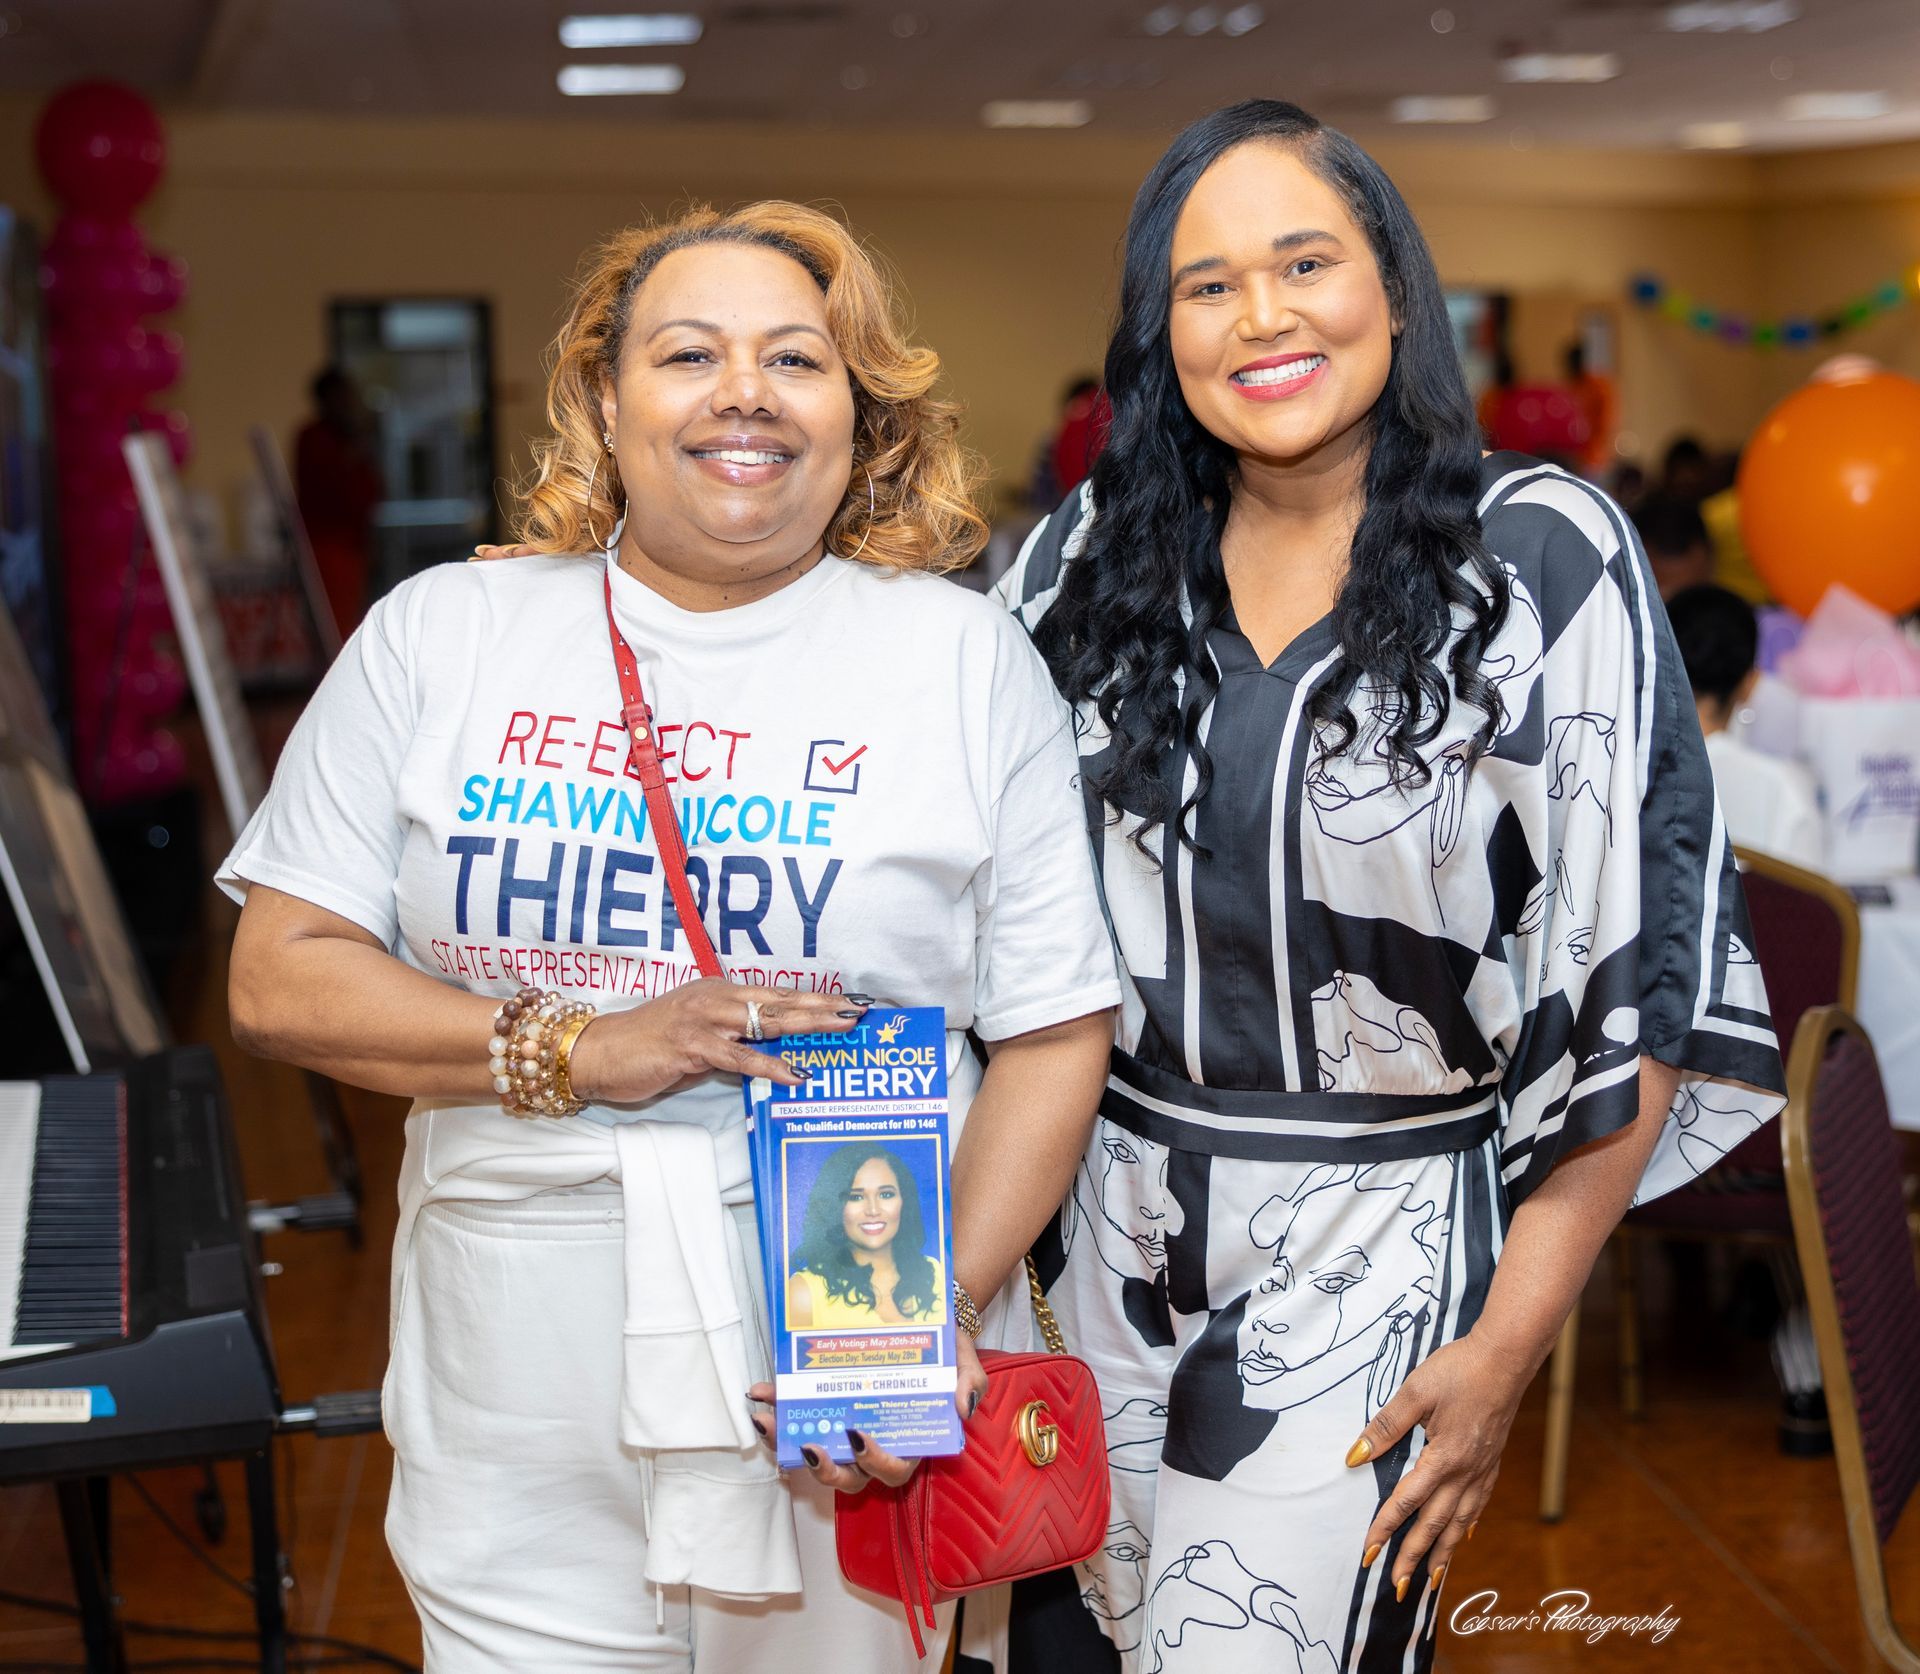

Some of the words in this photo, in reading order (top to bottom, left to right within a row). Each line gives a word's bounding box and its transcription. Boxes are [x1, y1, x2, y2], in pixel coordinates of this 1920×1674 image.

[457, 774, 650, 843] SHAWN
[446, 836, 844, 958] THIERRY
[431, 939, 491, 980] STATE
[811, 971, 843, 995] 146
[780, 1048, 857, 1068] SHAWN
[864, 1047, 936, 1066] NICOLE
[779, 1106, 803, 1115] TEXAS
[805, 1105, 826, 1114] STATE
[829, 1104, 890, 1113] REPRESENTATIVE
[893, 1103, 925, 1112] DISTRICT
[928, 1103, 943, 1111] 146
[786, 1122, 802, 1132] The
[804, 1120, 843, 1133] Qualified
[845, 1119, 887, 1131] Democrat
[889, 1119, 902, 1130] for
[903, 1119, 916, 1129] HD
[918, 1118, 937, 1129] 146!
[817, 1340, 837, 1351] Early
[839, 1338, 868, 1350] Voting:
[870, 1338, 888, 1348] May
[889, 1335, 928, 1346] 20th-24th
[819, 1353, 844, 1363] Election
[861, 1352, 885, 1362] Tuesday
[887, 1351, 901, 1361] May
[816, 1381, 862, 1393] HOUSTON
[872, 1378, 928, 1390] CHRONICLE
[853, 1402, 880, 1410] Shawn
[881, 1400, 909, 1409] Thierry
[787, 1407, 847, 1420] DEMOCRAT
